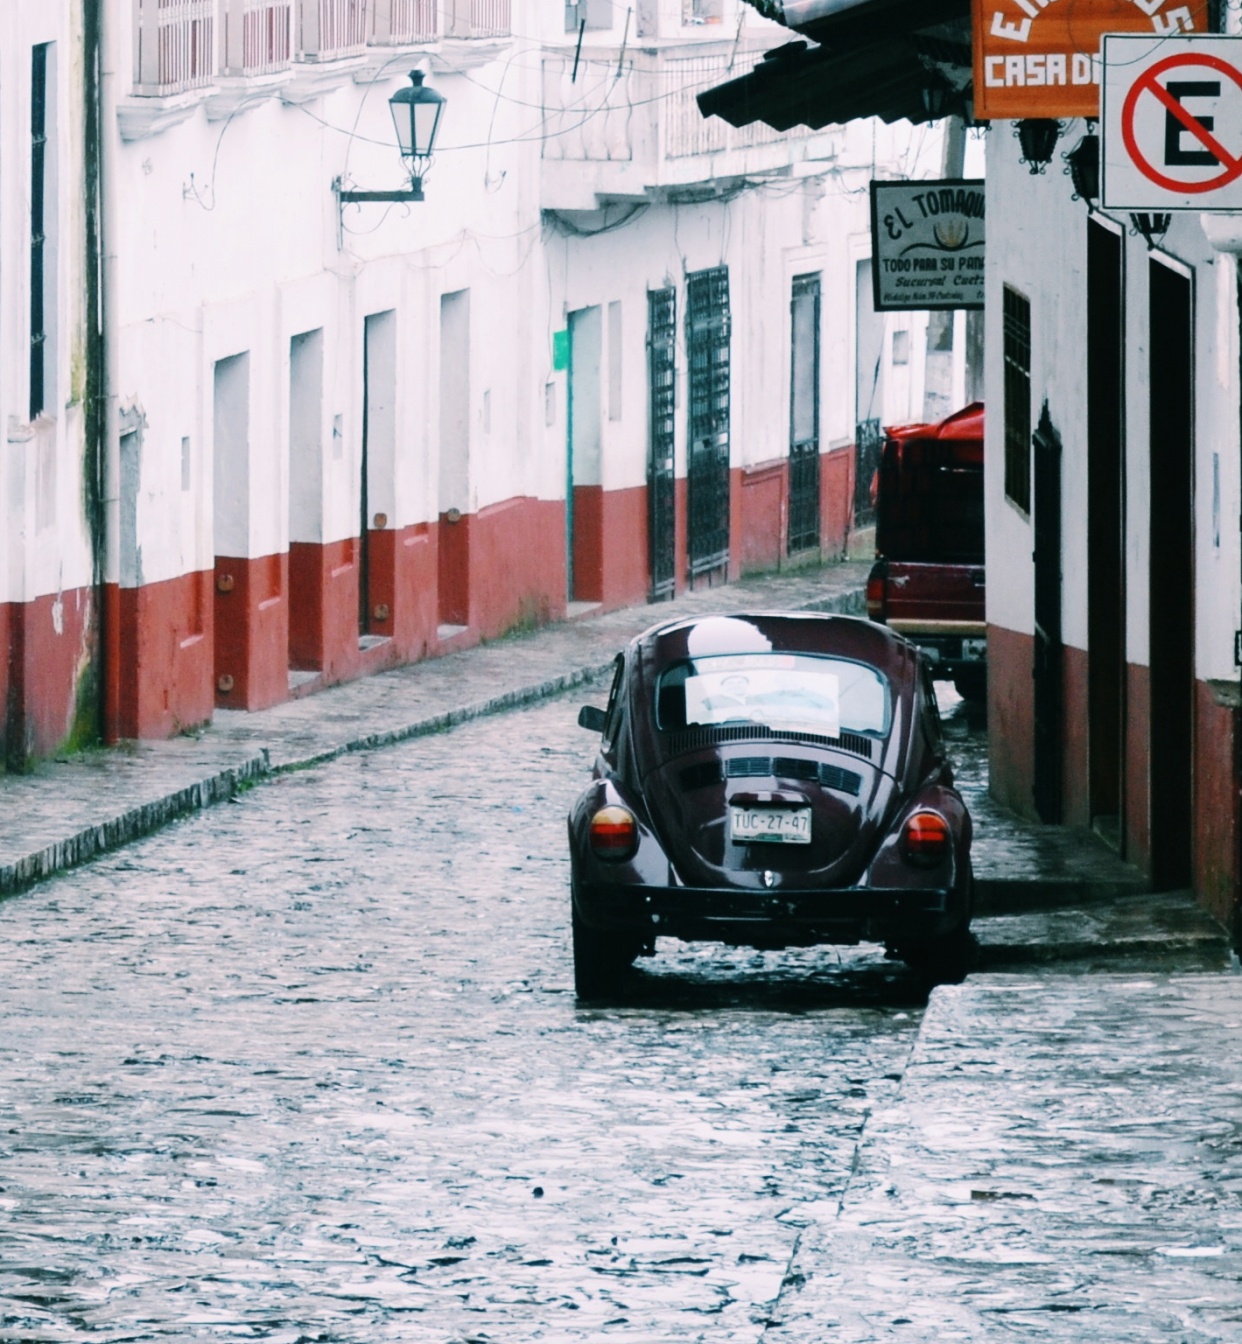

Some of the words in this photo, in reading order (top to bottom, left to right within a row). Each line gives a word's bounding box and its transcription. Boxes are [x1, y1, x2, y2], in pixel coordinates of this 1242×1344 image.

[984, 53, 1067, 88] CASA
[1164, 81, 1221, 166] E
[882, 259, 911, 272] TODO
[913, 258, 937, 271] PARA
[940, 258, 955, 271] SU
[735, 813, 808, 831] TUC-27-47
